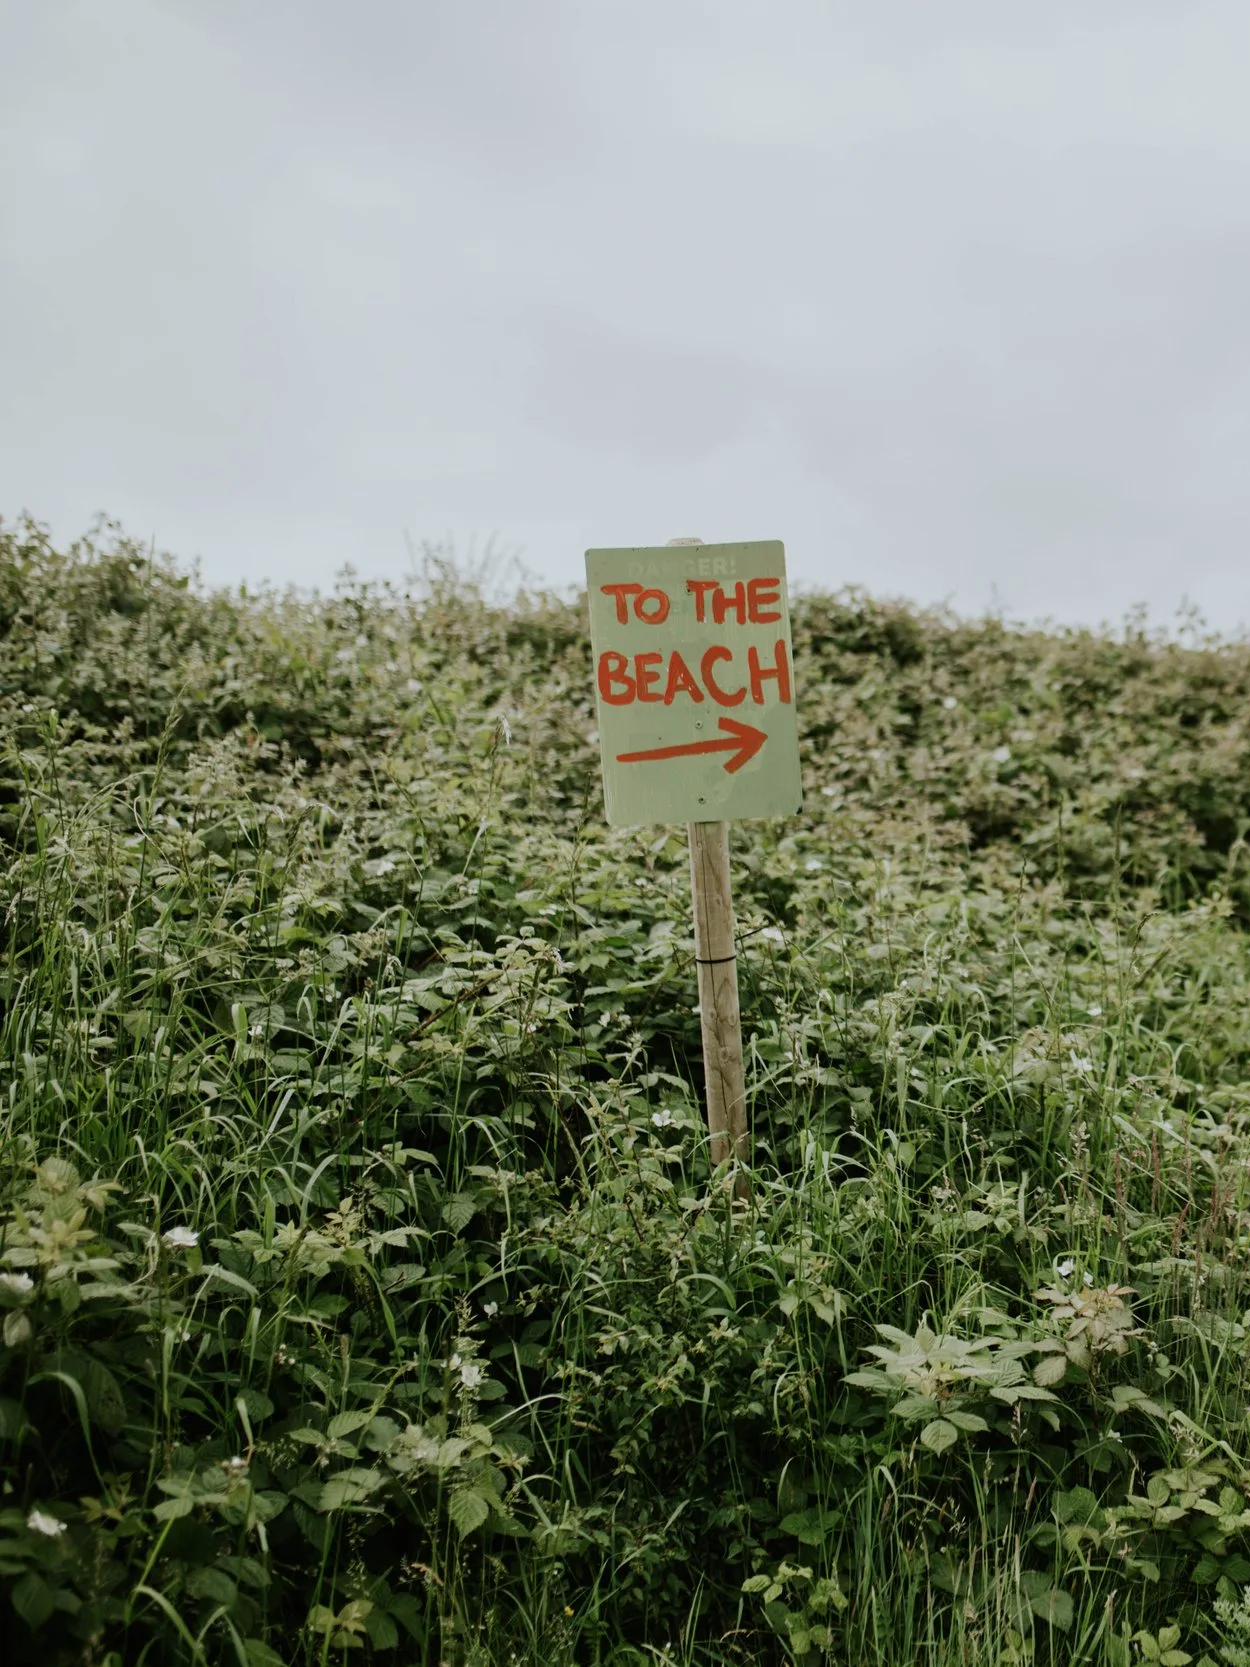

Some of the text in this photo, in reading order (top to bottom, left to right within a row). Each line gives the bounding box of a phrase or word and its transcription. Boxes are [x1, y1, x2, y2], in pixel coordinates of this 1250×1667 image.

[600, 577, 782, 625] TO THE
[597, 639, 792, 707] BEACH
